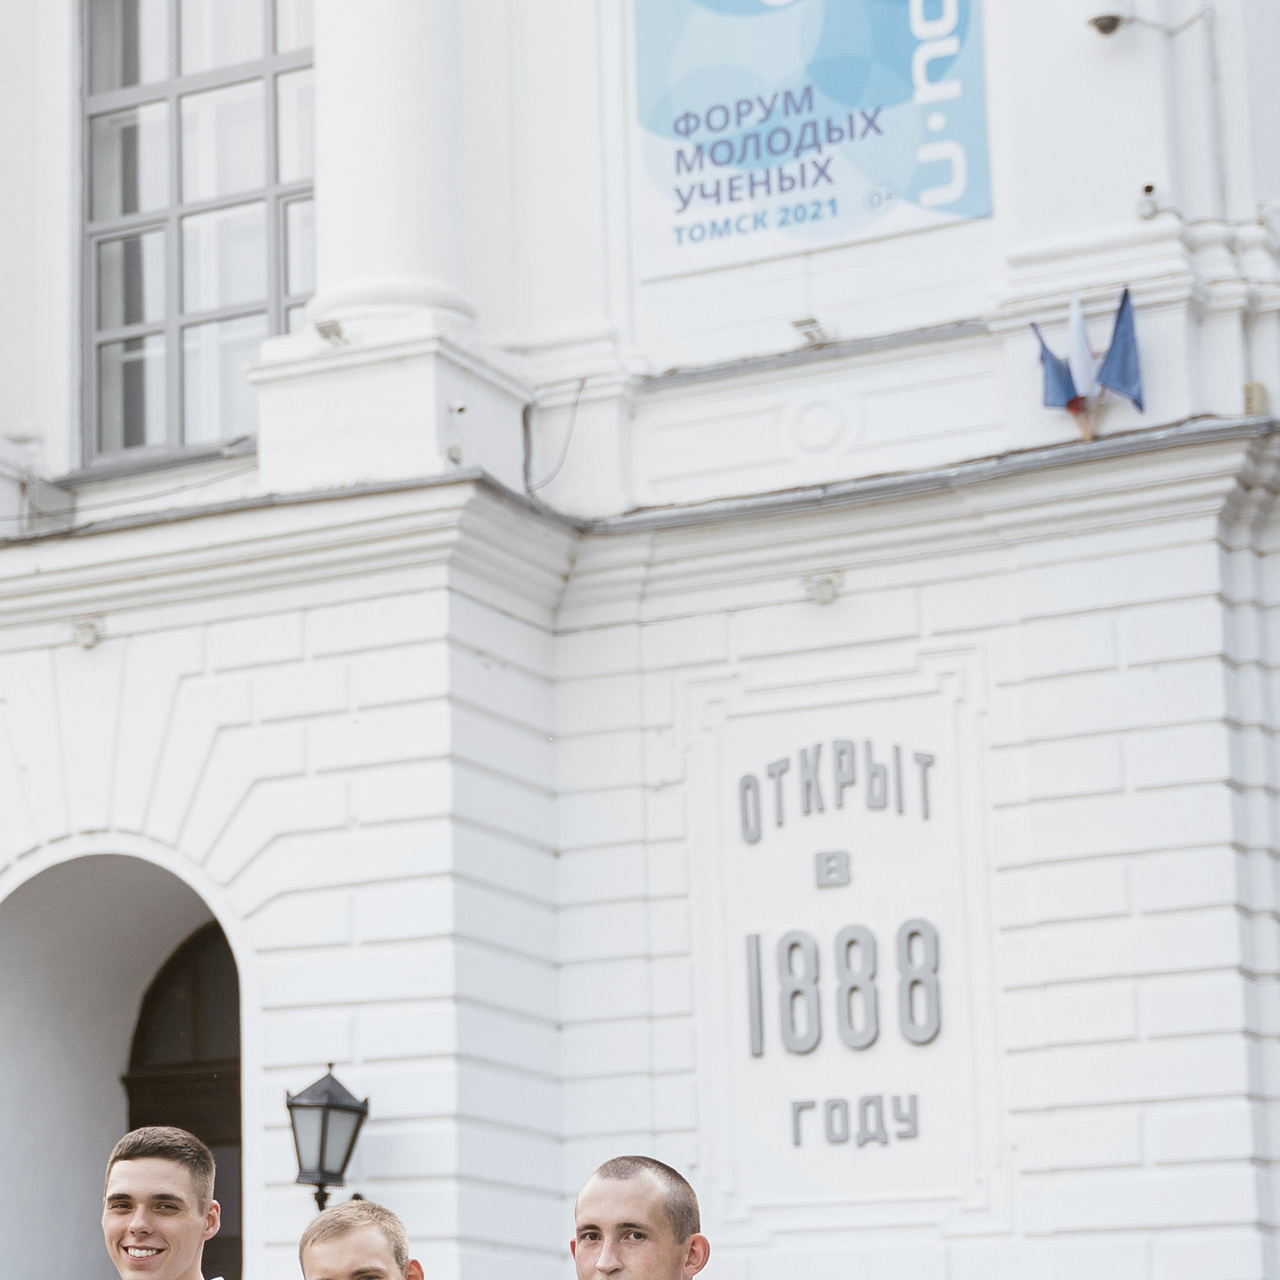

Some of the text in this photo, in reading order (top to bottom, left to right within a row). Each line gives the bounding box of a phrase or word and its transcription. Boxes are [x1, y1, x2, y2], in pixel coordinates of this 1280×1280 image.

[673, 85, 815, 137] ФОРУМ
[674, 107, 884, 175] МОЛОДЫХ
[675, 158, 834, 213] УЧЕНЫХ
[674, 198, 839, 246] ТОМСК 2021
[739, 739, 934, 843] ОТКРЫТ
[815, 851, 851, 888] В
[746, 918, 941, 1058] 1888
[792, 1094, 919, 1146] ГОДУ
